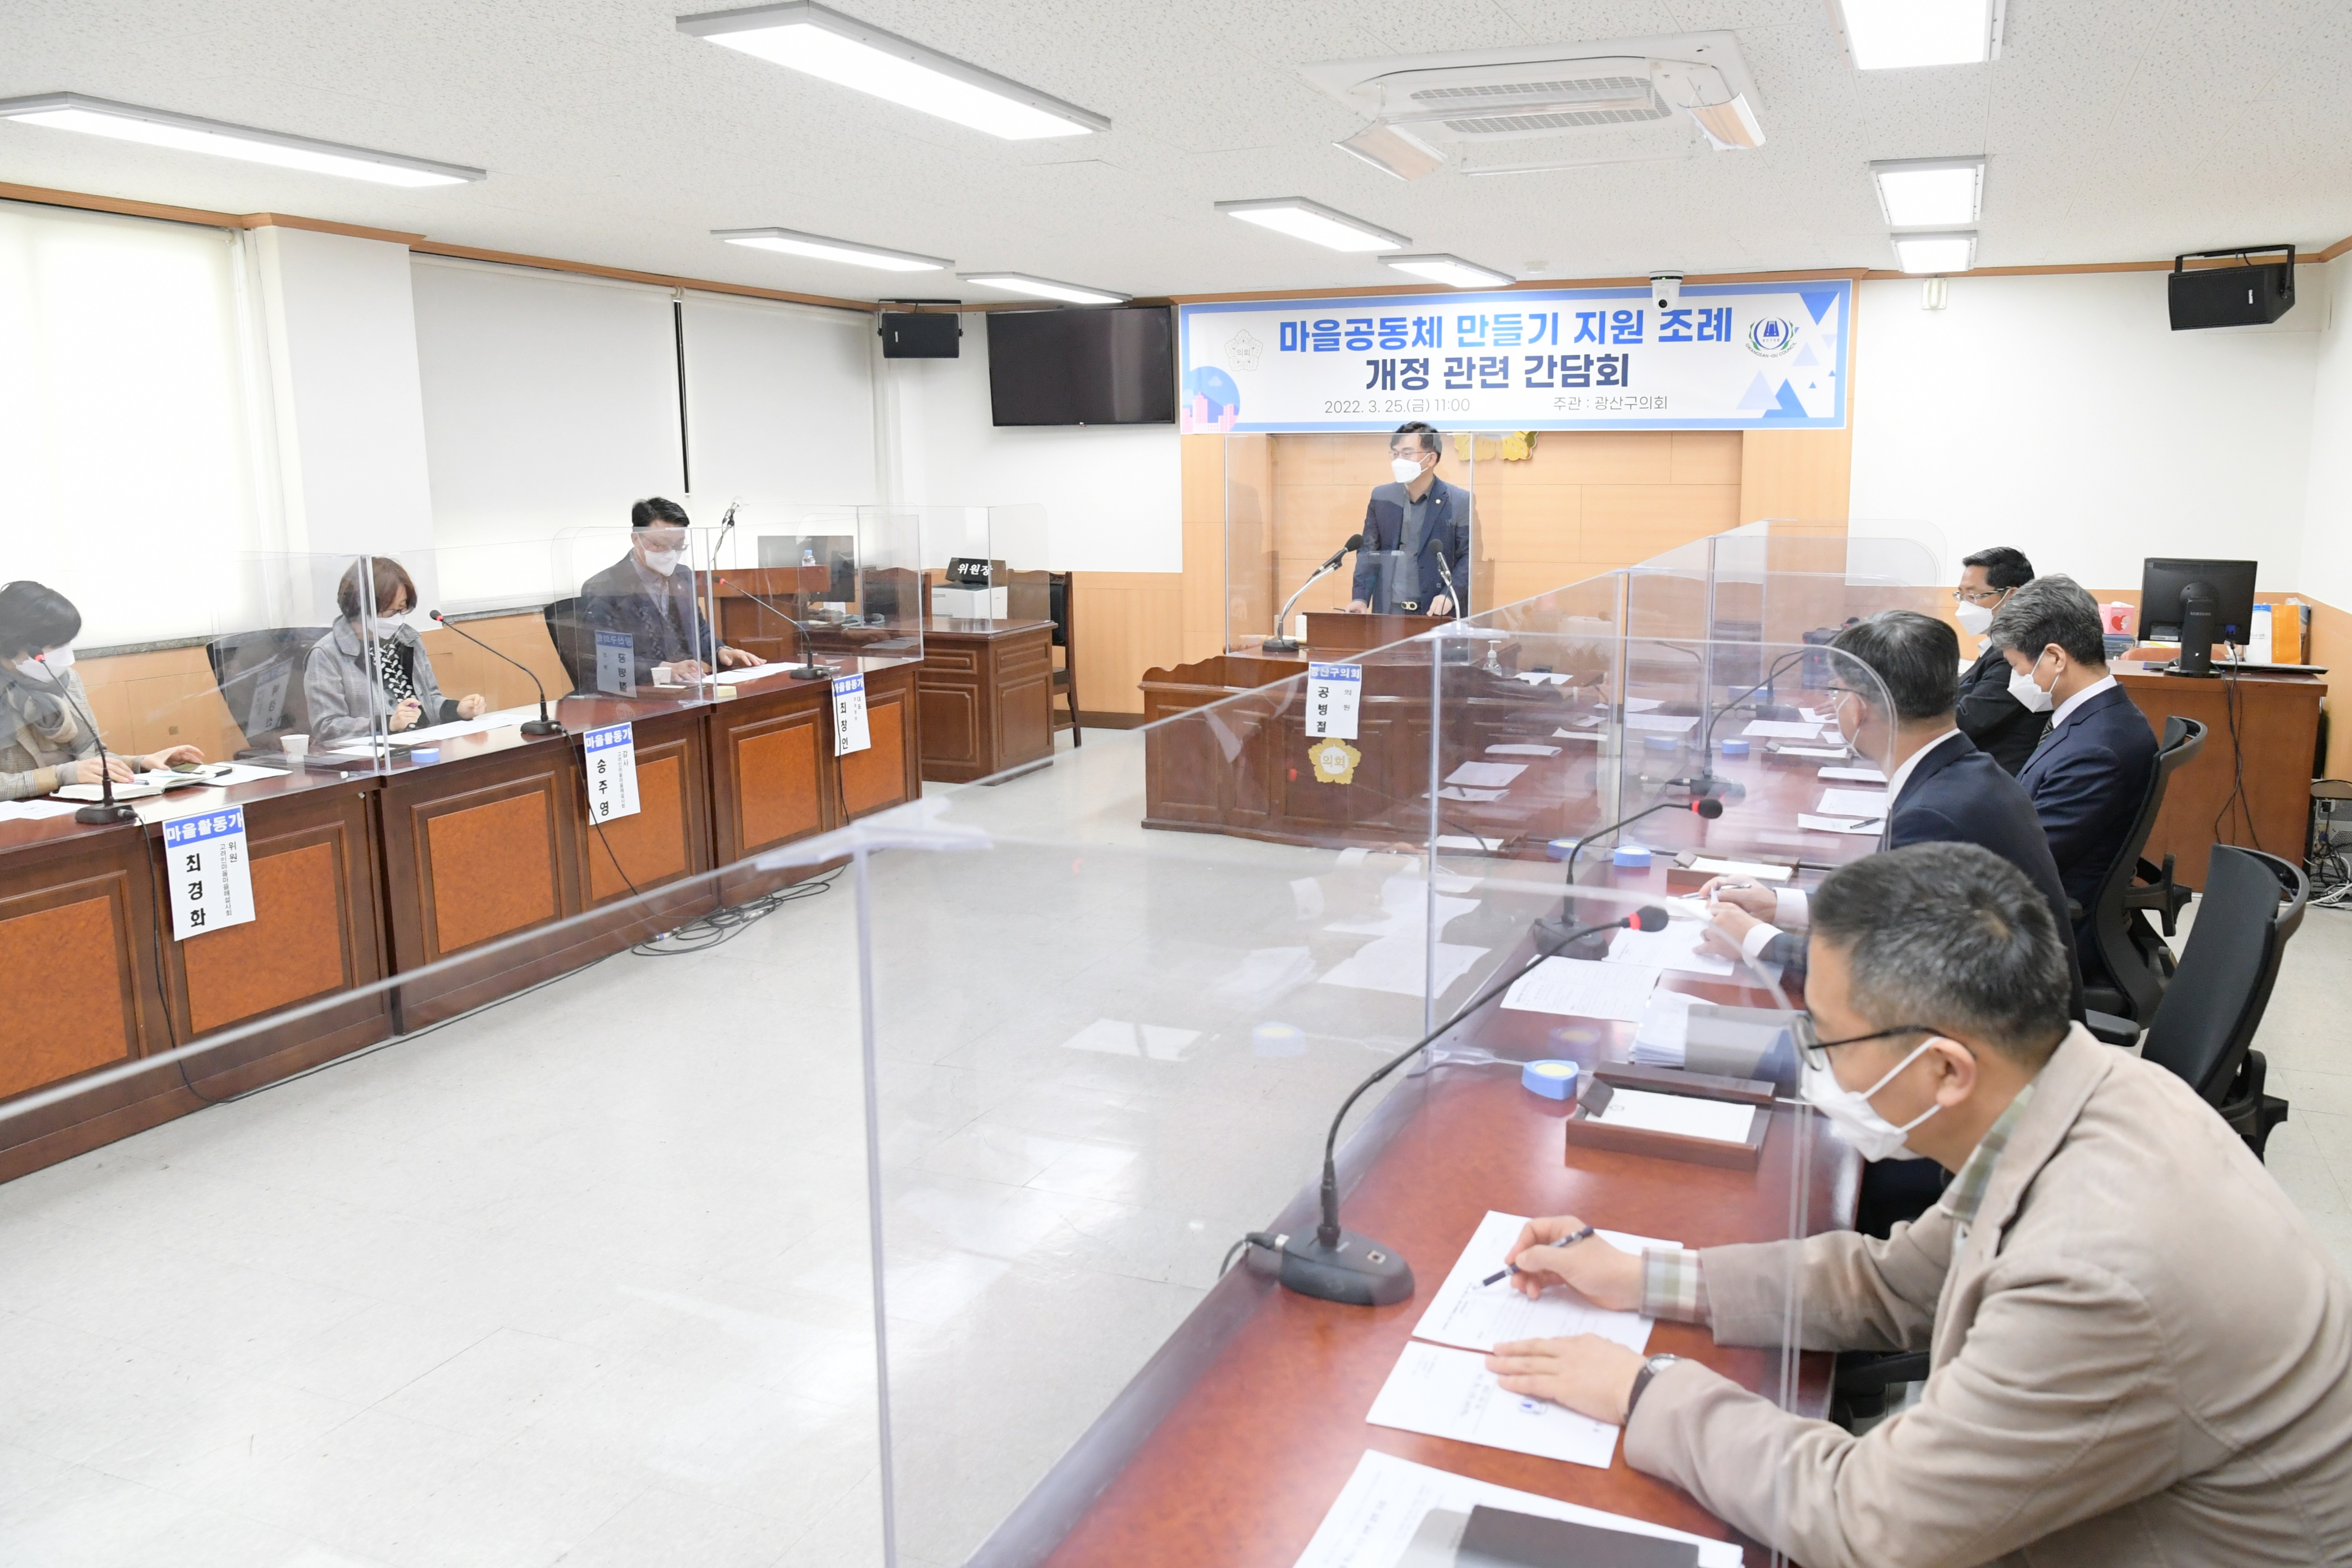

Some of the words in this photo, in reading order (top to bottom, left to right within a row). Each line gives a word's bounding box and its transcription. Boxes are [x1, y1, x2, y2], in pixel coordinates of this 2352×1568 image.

[1280, 315, 1443, 352] 마을공동체
[1457, 312, 1559, 348] 만들기
[1574, 310, 1644, 345] 지원
[1658, 307, 1732, 343] 조례
[1237, 348, 1251, 357] 의회
[1745, 343, 1778, 358] GWANGSAN-GU
[1778, 342, 1797, 357] COUNCIL
[1366, 358, 1430, 391] 개정
[1443, 356, 1509, 389] 관련
[1524, 353, 1629, 388] 간담회
[1324, 400, 1364, 414] 2022.
[1368, 400, 1380, 413] 3.
[1385, 398, 1430, 413] 25.(금)
[1435, 398, 1470, 412] 11:00
[1553, 396, 1581, 411] 주관
[1594, 395, 1668, 411] 광산구의회
[958, 563, 993, 576] 위원장
[1310, 666, 1360, 679] 광산구의회
[586, 727, 631, 749] 마을활동가
[623, 750, 629, 766] 감사
[1322, 755, 1345, 768] 의회
[597, 759, 609, 816] 송주영
[166, 812, 243, 841] 마을활동가
[228, 841, 237, 863] 위원
[186, 853, 206, 928] 최경화
